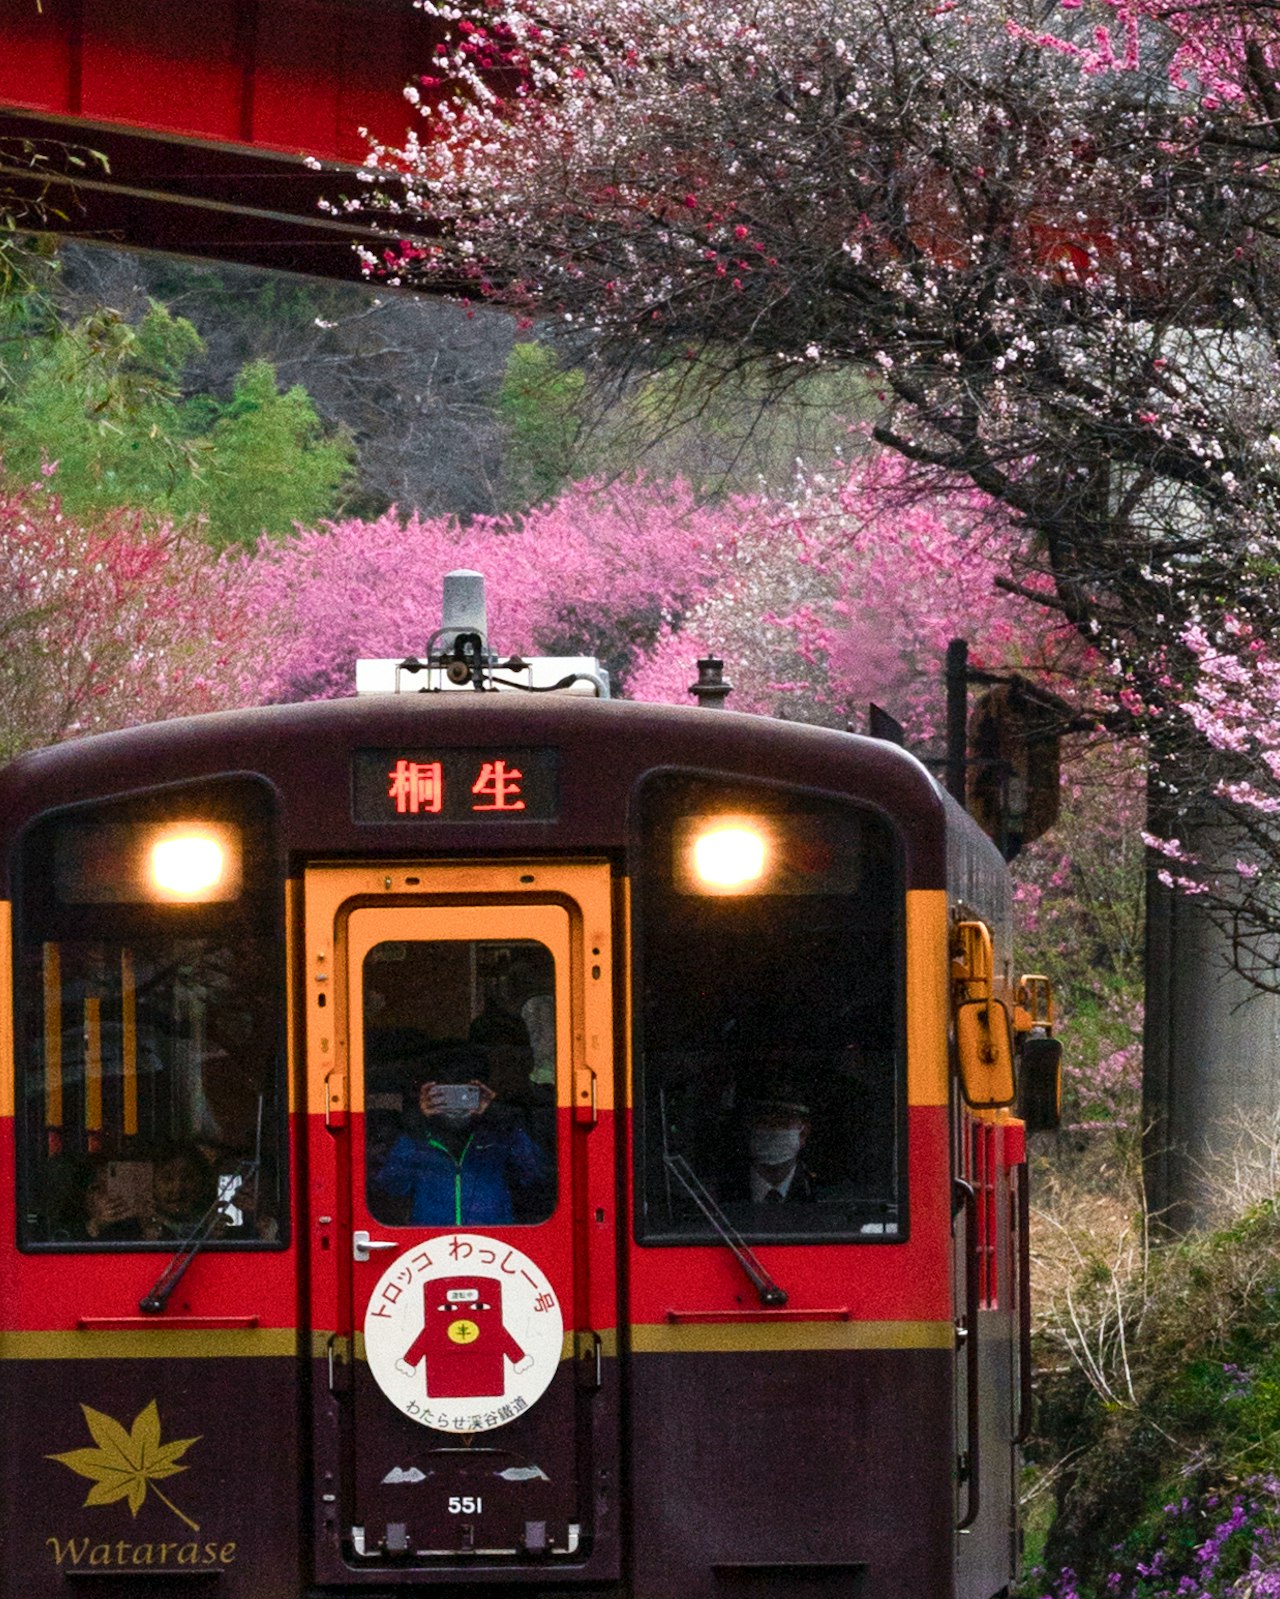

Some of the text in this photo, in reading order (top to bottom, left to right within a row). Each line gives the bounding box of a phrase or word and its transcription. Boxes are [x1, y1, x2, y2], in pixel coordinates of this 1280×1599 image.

[370, 1235, 556, 1319] トロッコ わっしー号
[447, 1496, 483, 1515] 551
[45, 1536, 237, 1567] Watarase
